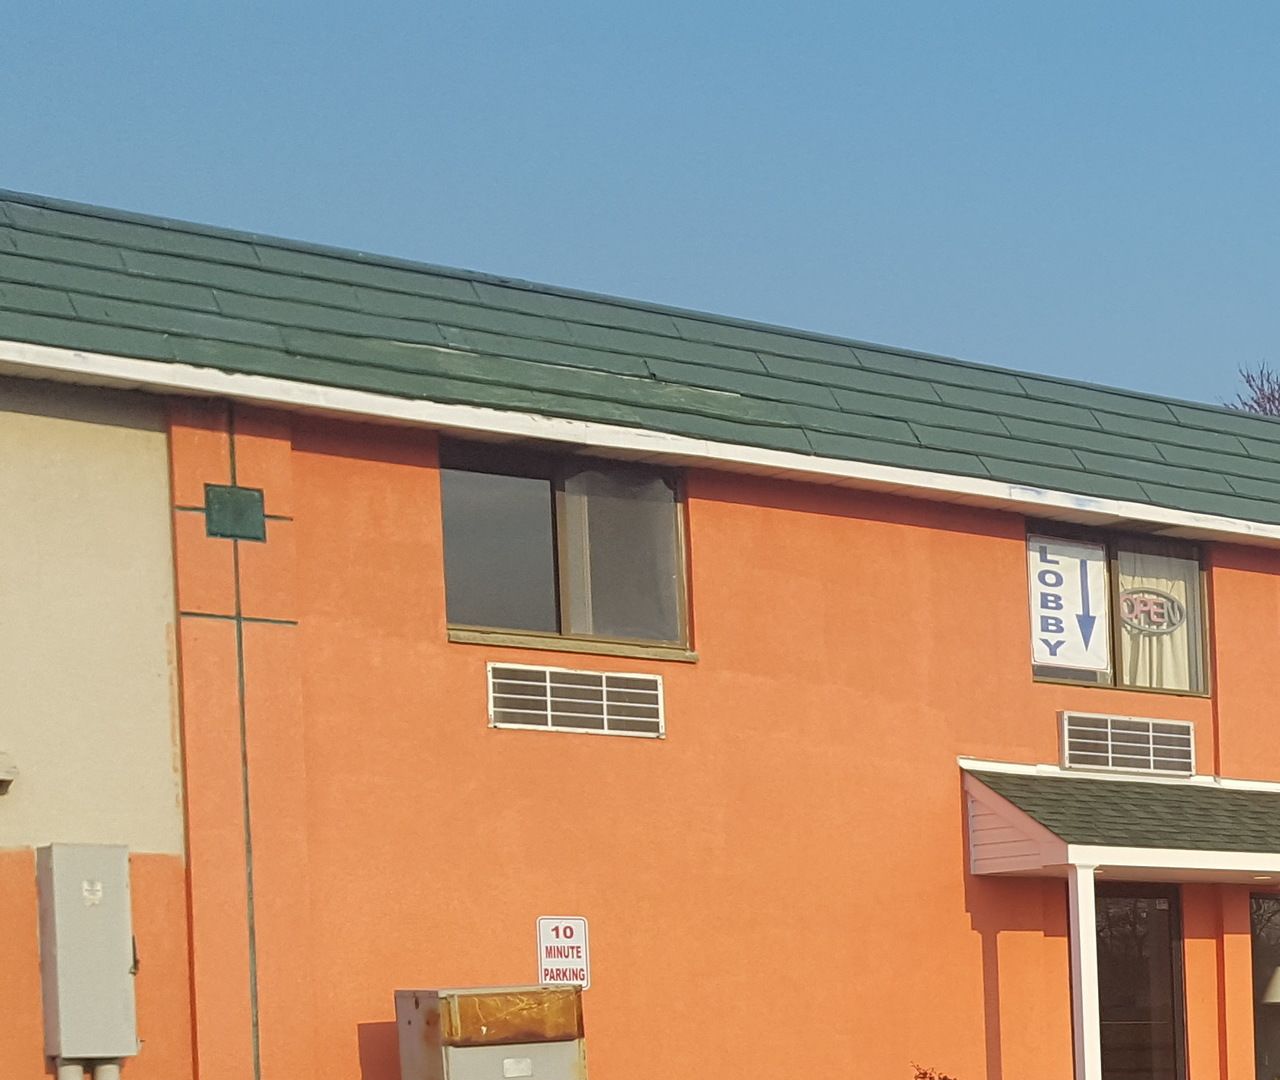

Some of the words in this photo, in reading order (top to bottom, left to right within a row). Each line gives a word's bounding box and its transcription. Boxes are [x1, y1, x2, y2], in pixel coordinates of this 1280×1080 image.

[1037, 546, 1066, 657] LOBBY
[1120, 593, 1180, 625] OPEN
[550, 925, 575, 939] 10
[545, 945, 583, 959] MINUTE
[543, 967, 586, 981] PARKING
